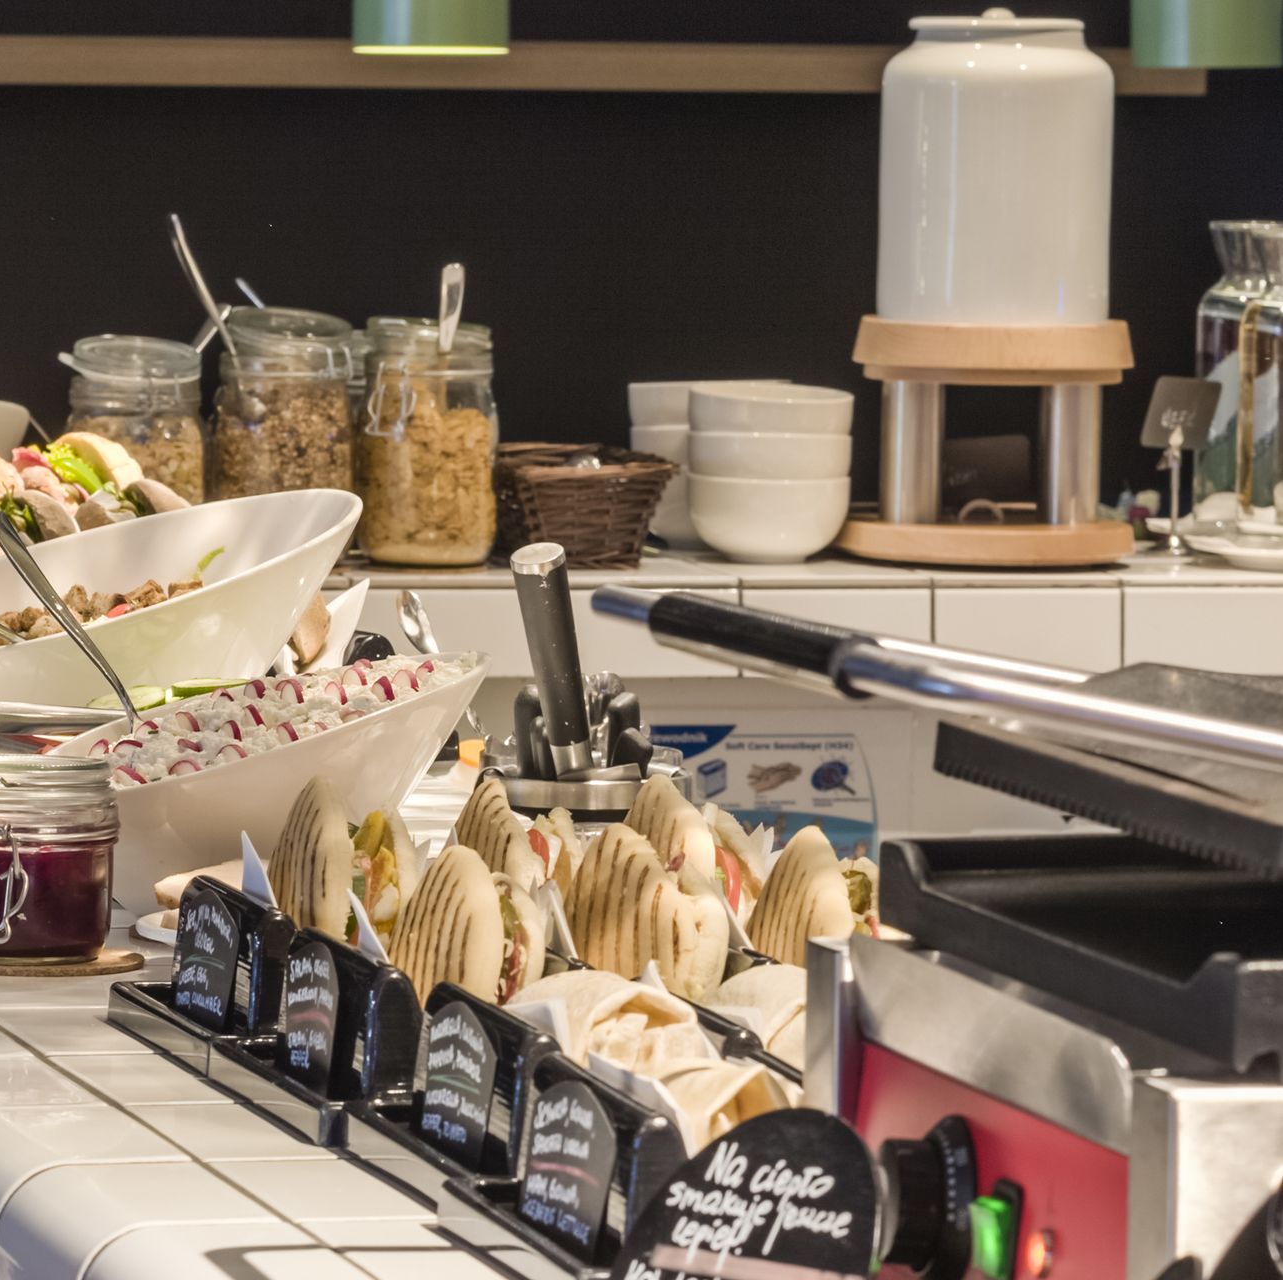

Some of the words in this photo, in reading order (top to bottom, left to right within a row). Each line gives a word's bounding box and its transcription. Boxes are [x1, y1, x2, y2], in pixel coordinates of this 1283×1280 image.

[651, 732, 708, 743] ewodnik
[704, 1141, 749, 1189] Na
[665, 1181, 774, 1240] smakuje
